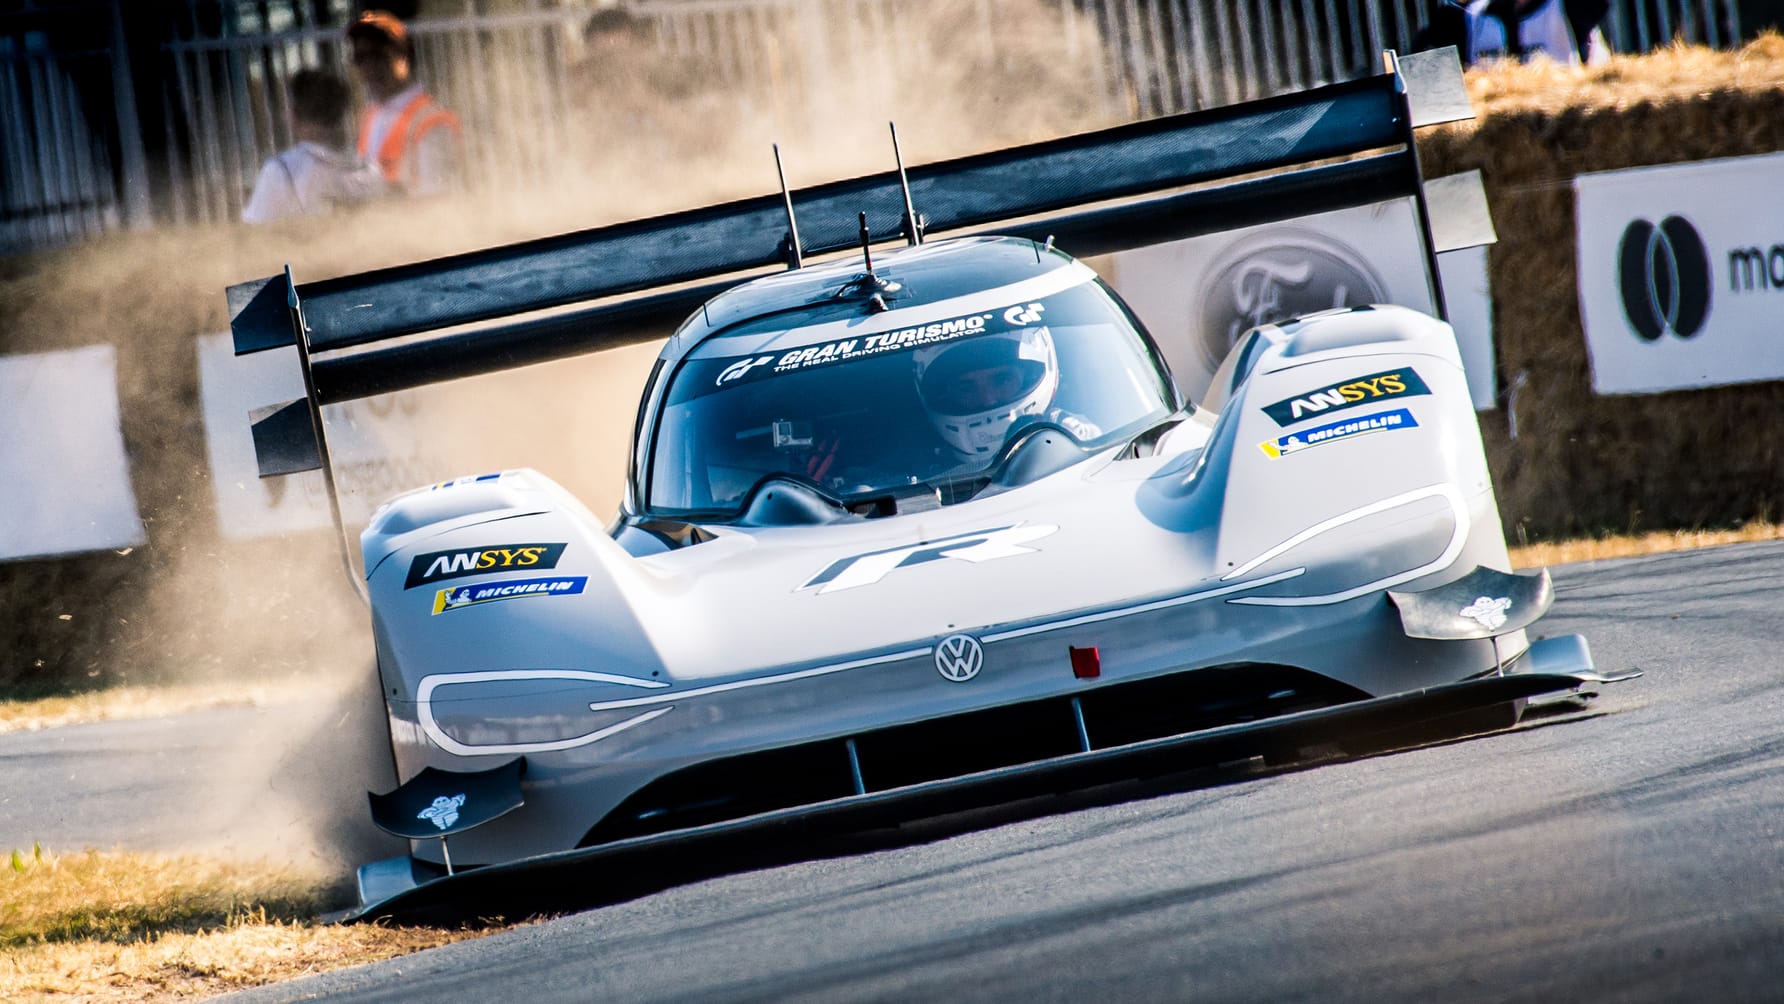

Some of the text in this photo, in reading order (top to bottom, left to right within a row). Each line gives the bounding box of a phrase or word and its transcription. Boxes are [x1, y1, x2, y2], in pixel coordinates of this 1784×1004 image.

[773, 326, 986, 373] THE REAL DRIVING SIMULATOR
[778, 340, 859, 366] GRAN
[864, 315, 985, 350] TURISMO
[1291, 374, 1407, 418] ANSYS
[1307, 414, 1403, 443] MICHELIN
[423, 547, 543, 578] ANSYS
[475, 581, 574, 599] MICHELIN
